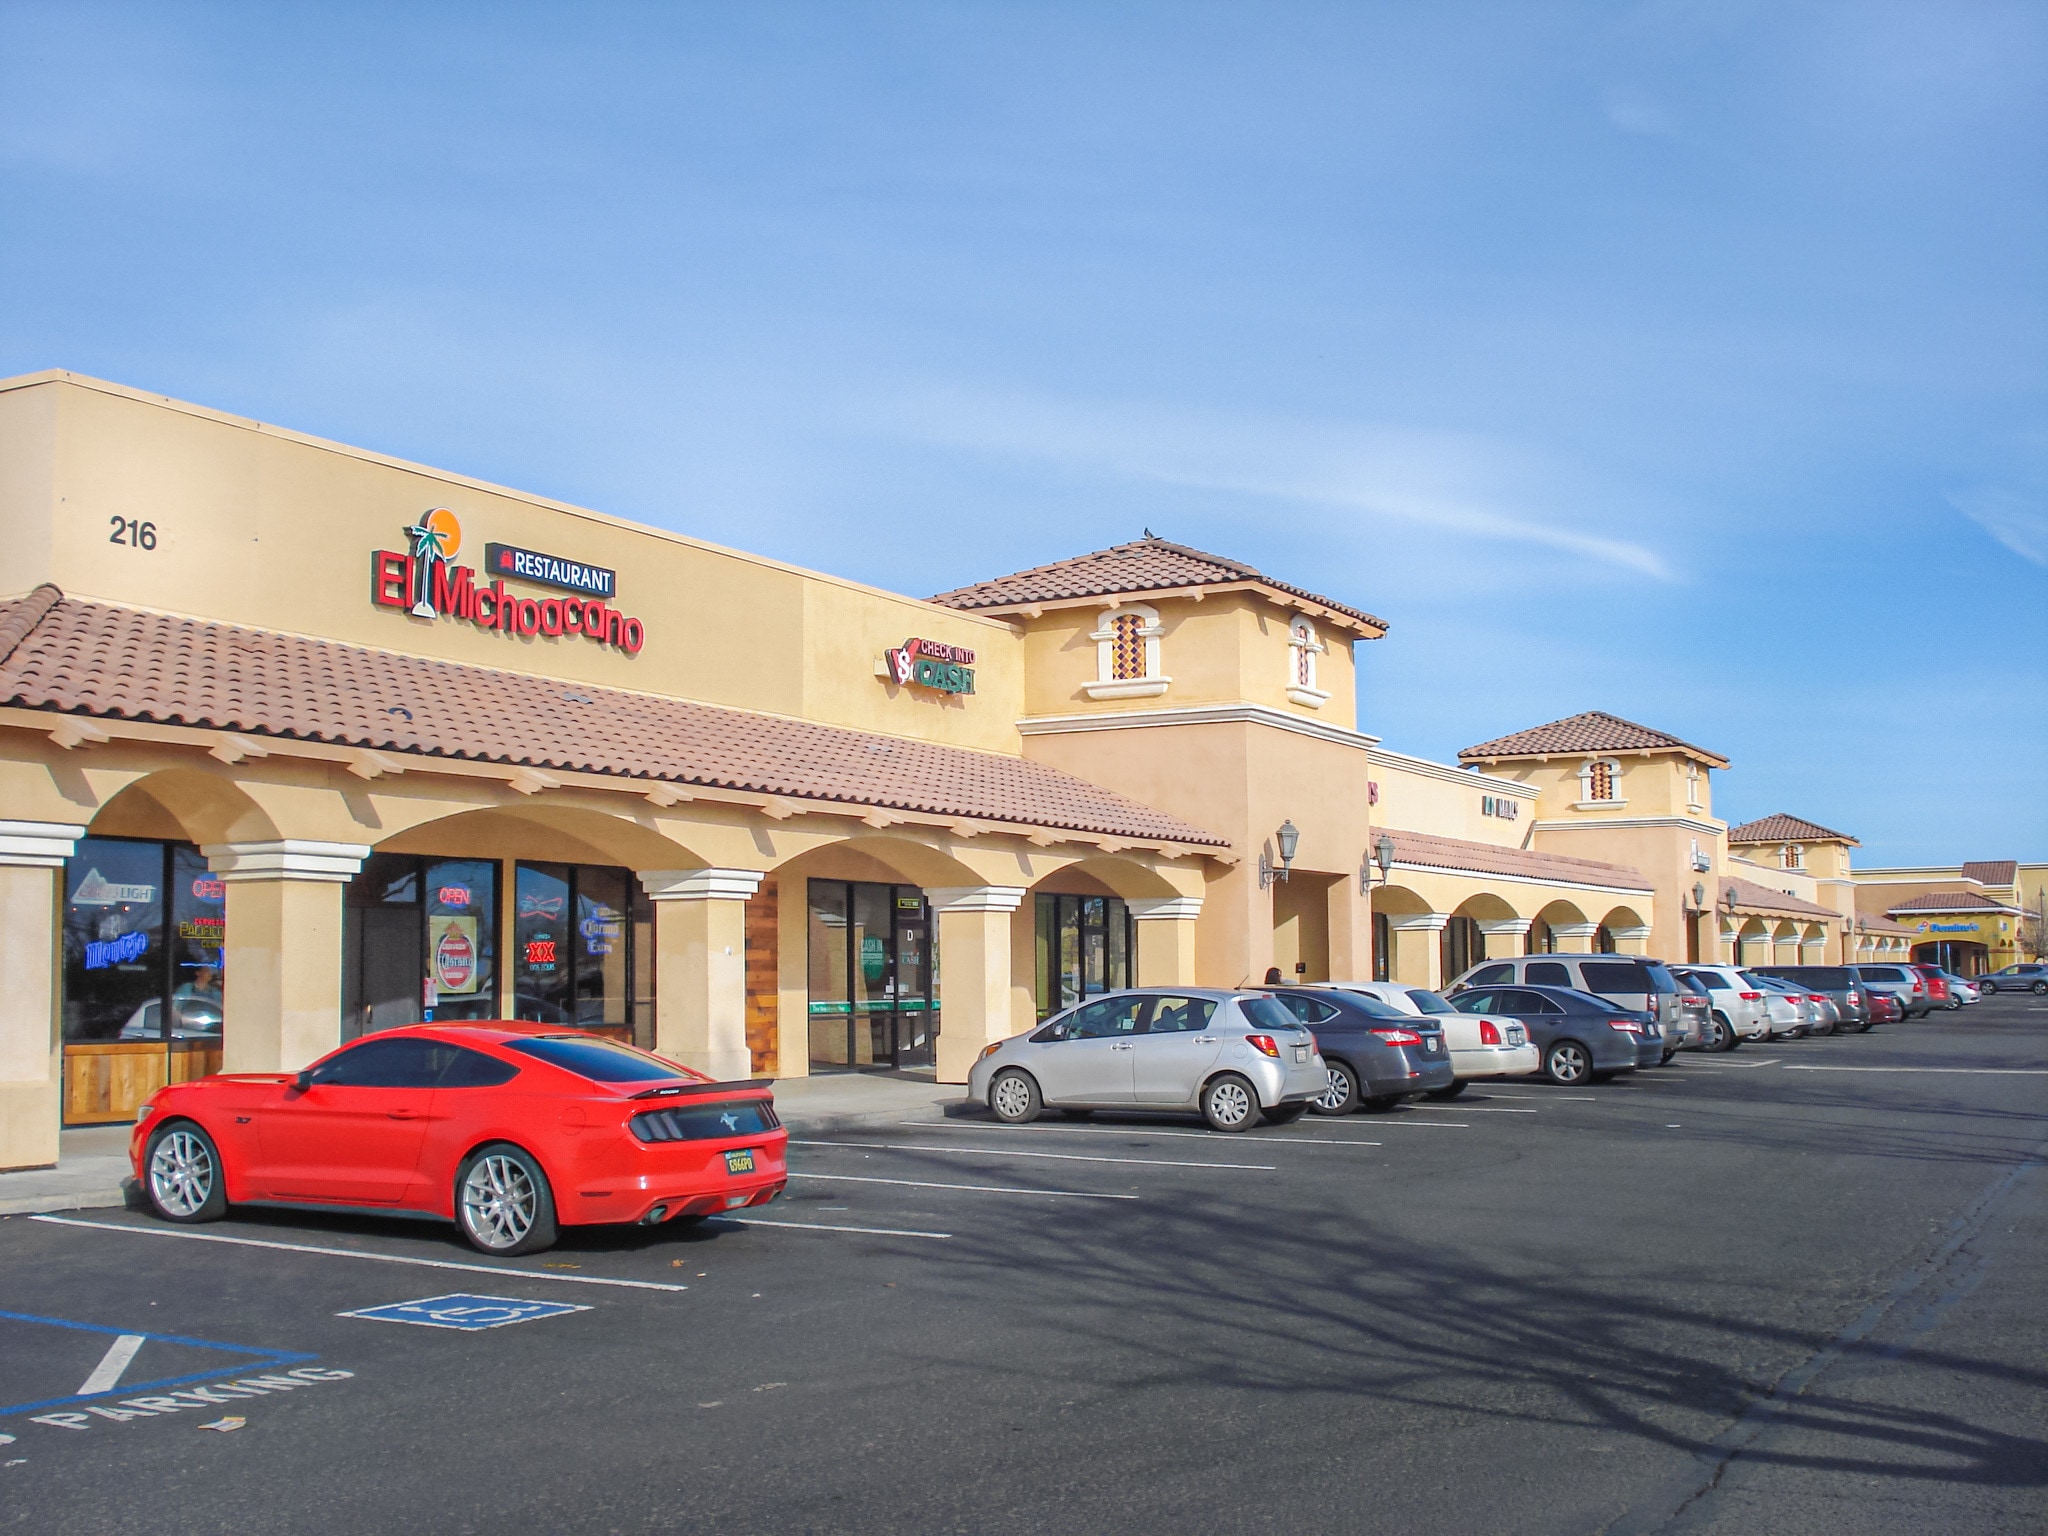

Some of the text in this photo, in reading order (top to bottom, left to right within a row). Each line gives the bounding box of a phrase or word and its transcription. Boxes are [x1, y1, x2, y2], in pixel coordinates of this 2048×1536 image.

[110, 515, 156, 551] 216
[515, 551, 610, 593] RESTAURANT
[373, 549, 644, 653] El Michoacano
[921, 640, 976, 664] CHECK INTO
[916, 661, 975, 694] CASH
[440, 887, 470, 904] OPEN
[907, 929, 914, 941] D
[529, 942, 556, 962] XX
[28, 1367, 355, 1430] PARKING
